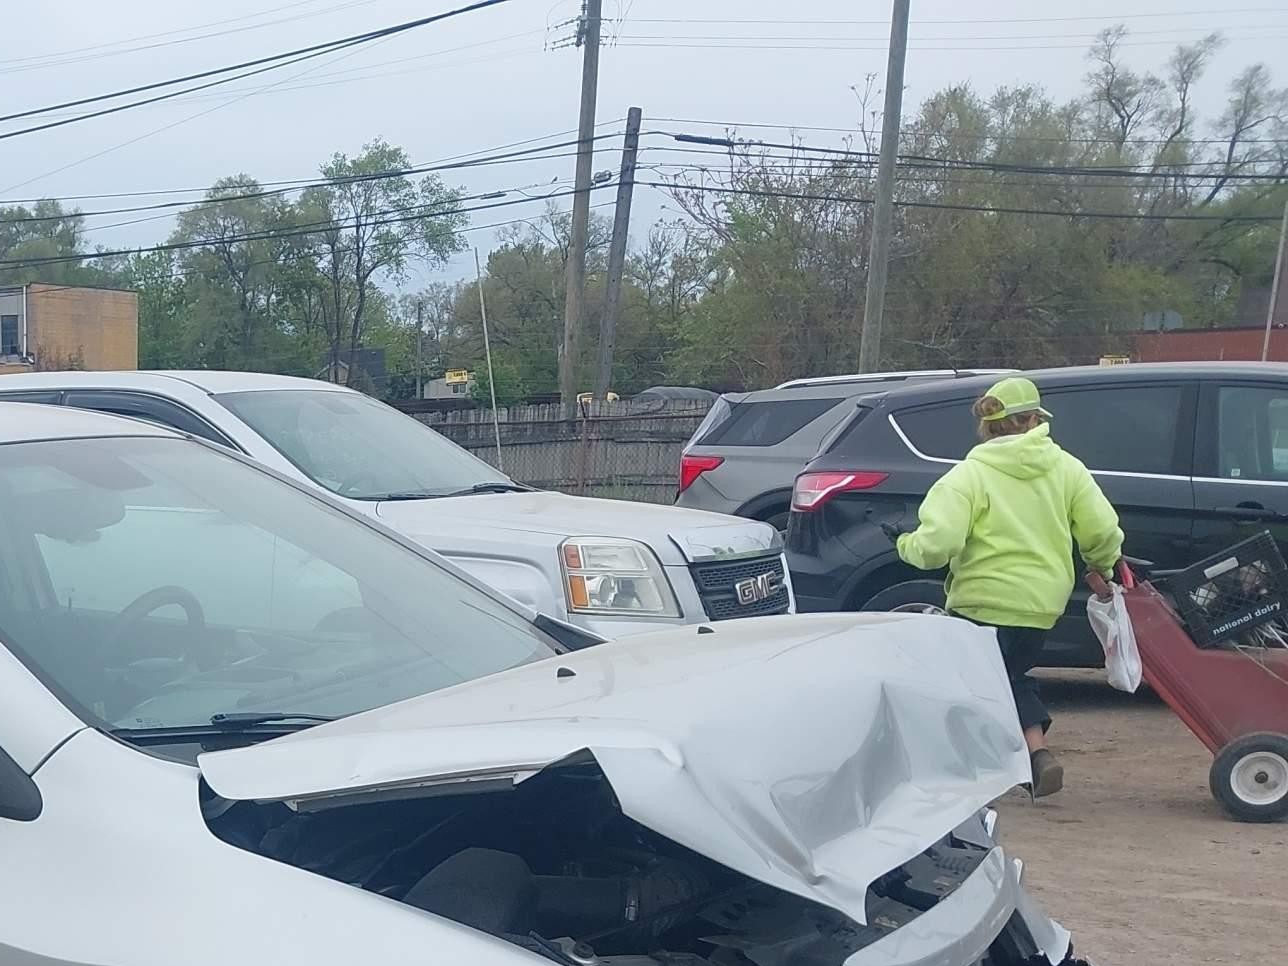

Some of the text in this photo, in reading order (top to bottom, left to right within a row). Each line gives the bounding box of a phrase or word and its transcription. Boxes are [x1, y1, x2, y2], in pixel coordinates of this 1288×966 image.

[735, 570, 779, 605] GMC
[1213, 601, 1281, 636] national dairy
